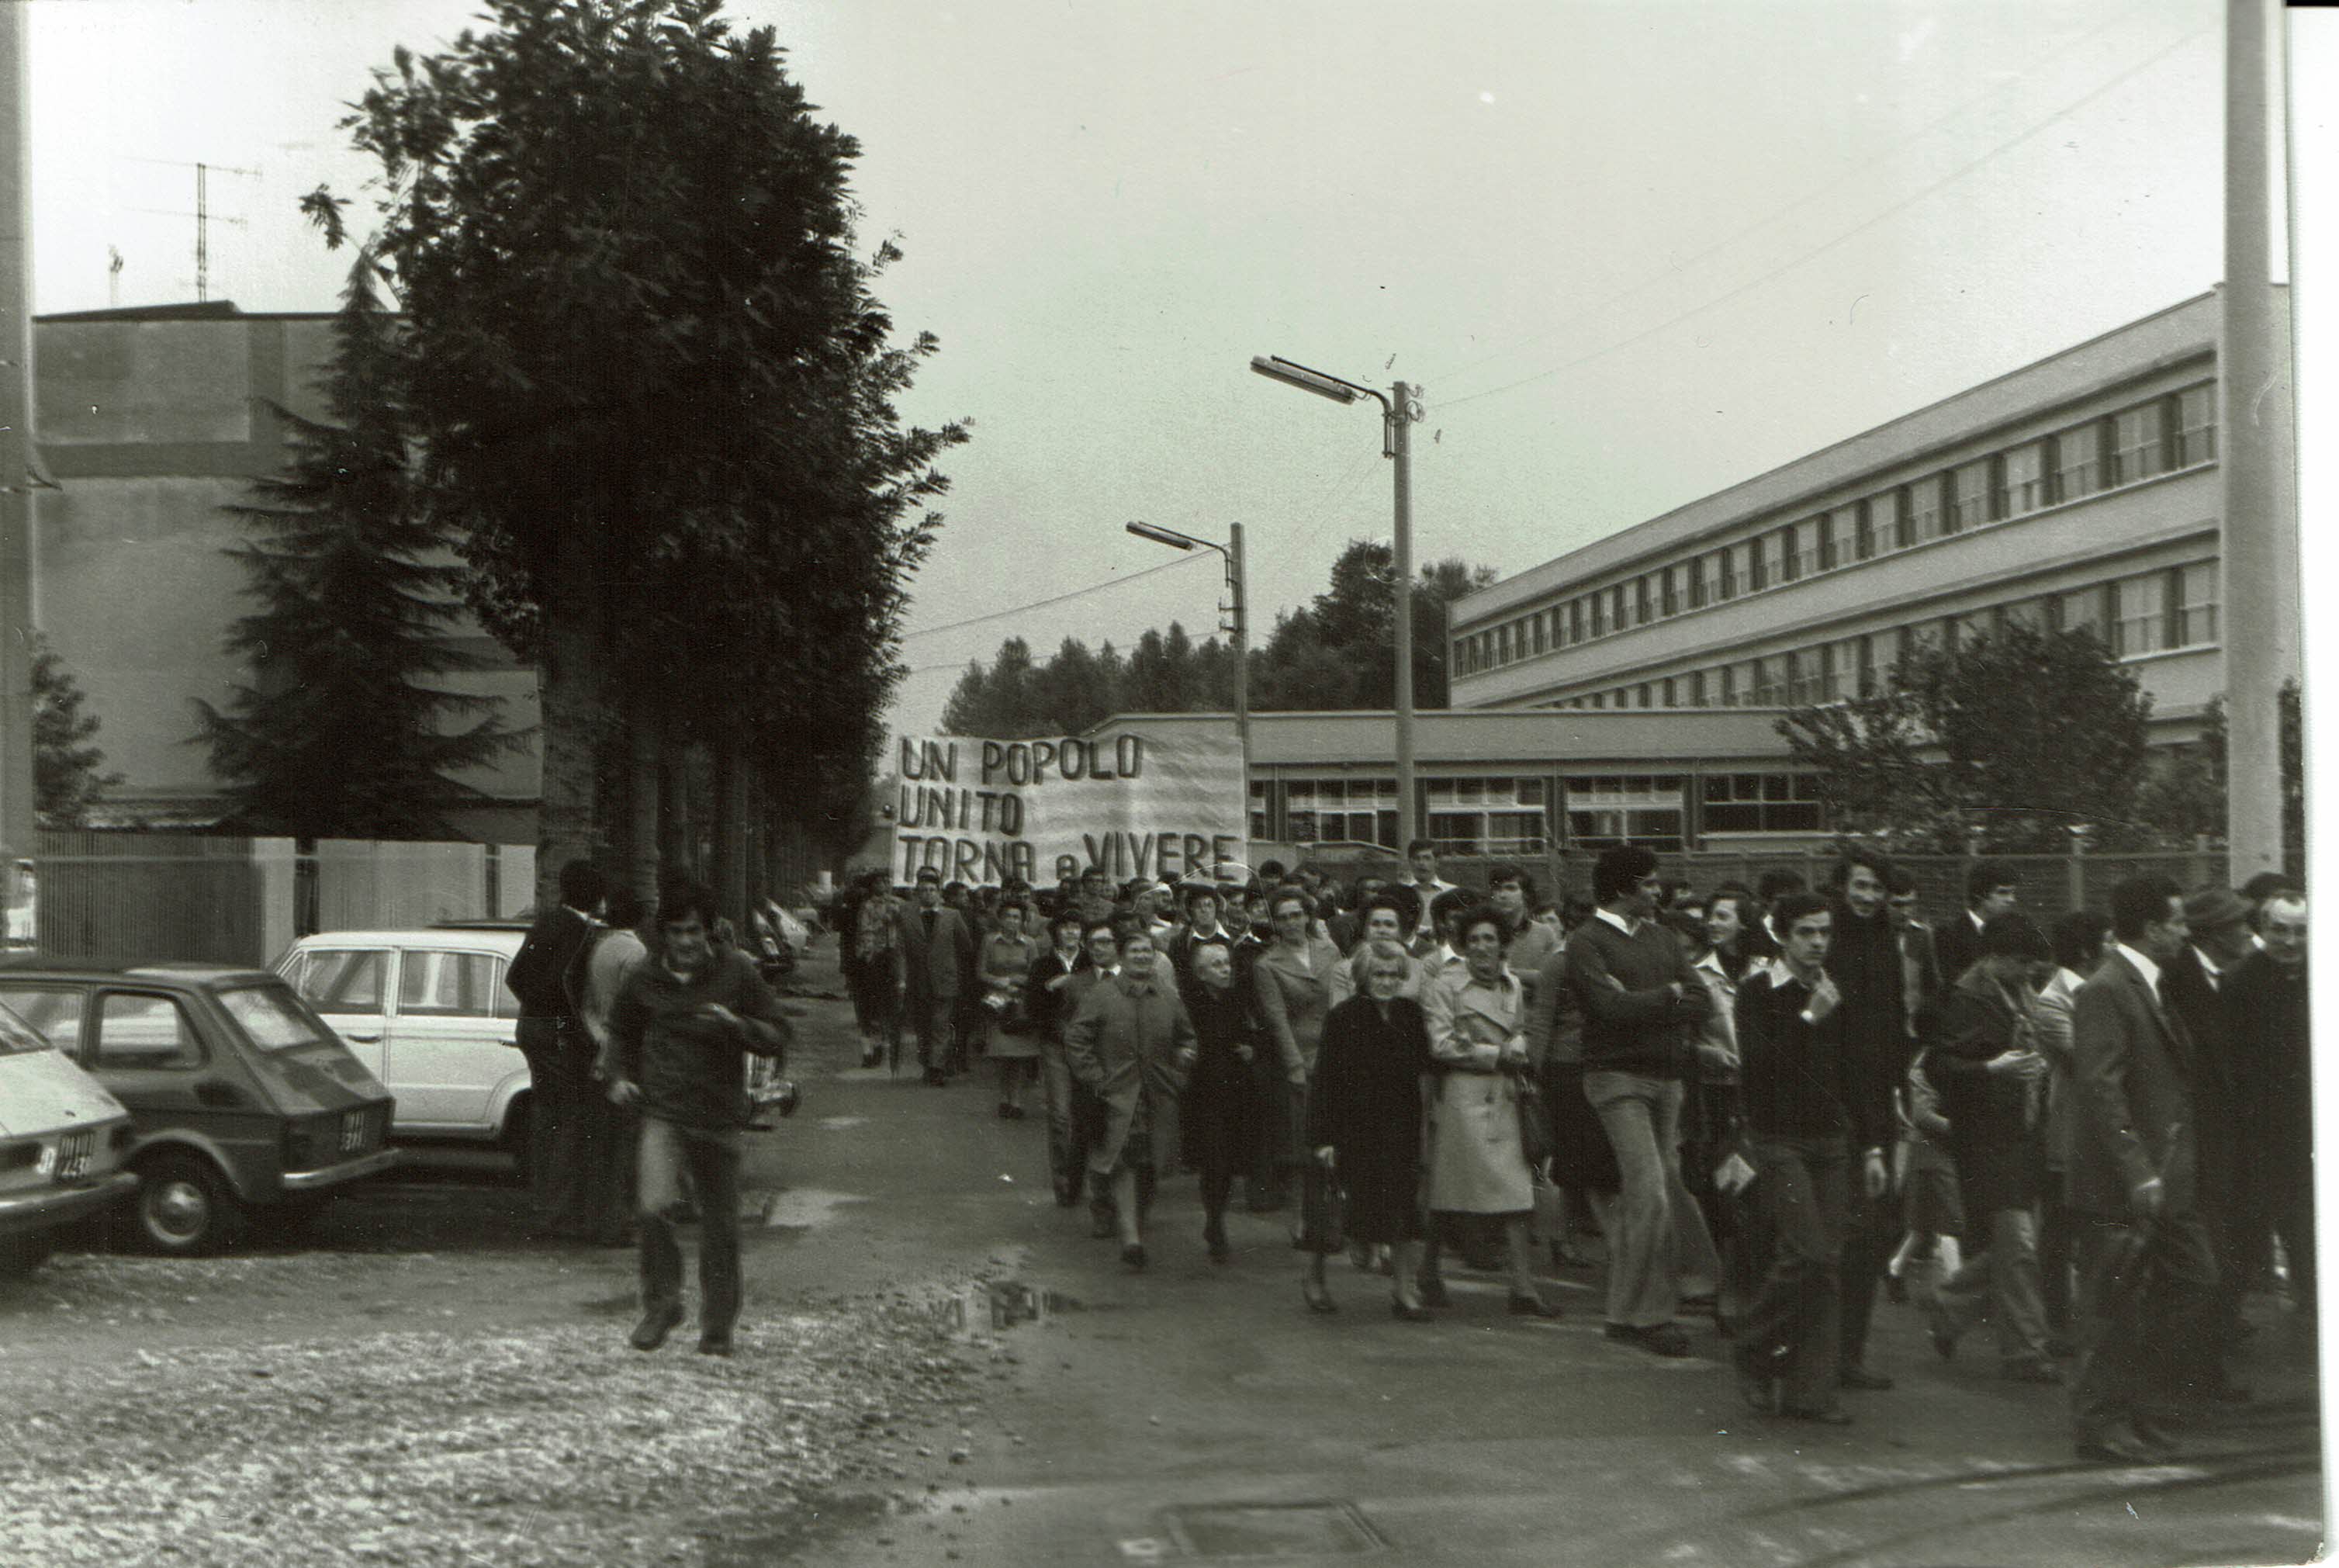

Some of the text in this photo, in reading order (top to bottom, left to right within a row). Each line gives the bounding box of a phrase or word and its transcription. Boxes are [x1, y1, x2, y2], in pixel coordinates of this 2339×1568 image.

[901, 734, 1142, 785] UN POPOLO
[900, 784, 1024, 836] UNITO
[898, 835, 1037, 883] TORNA
[1083, 831, 1240, 882] VIVERE
